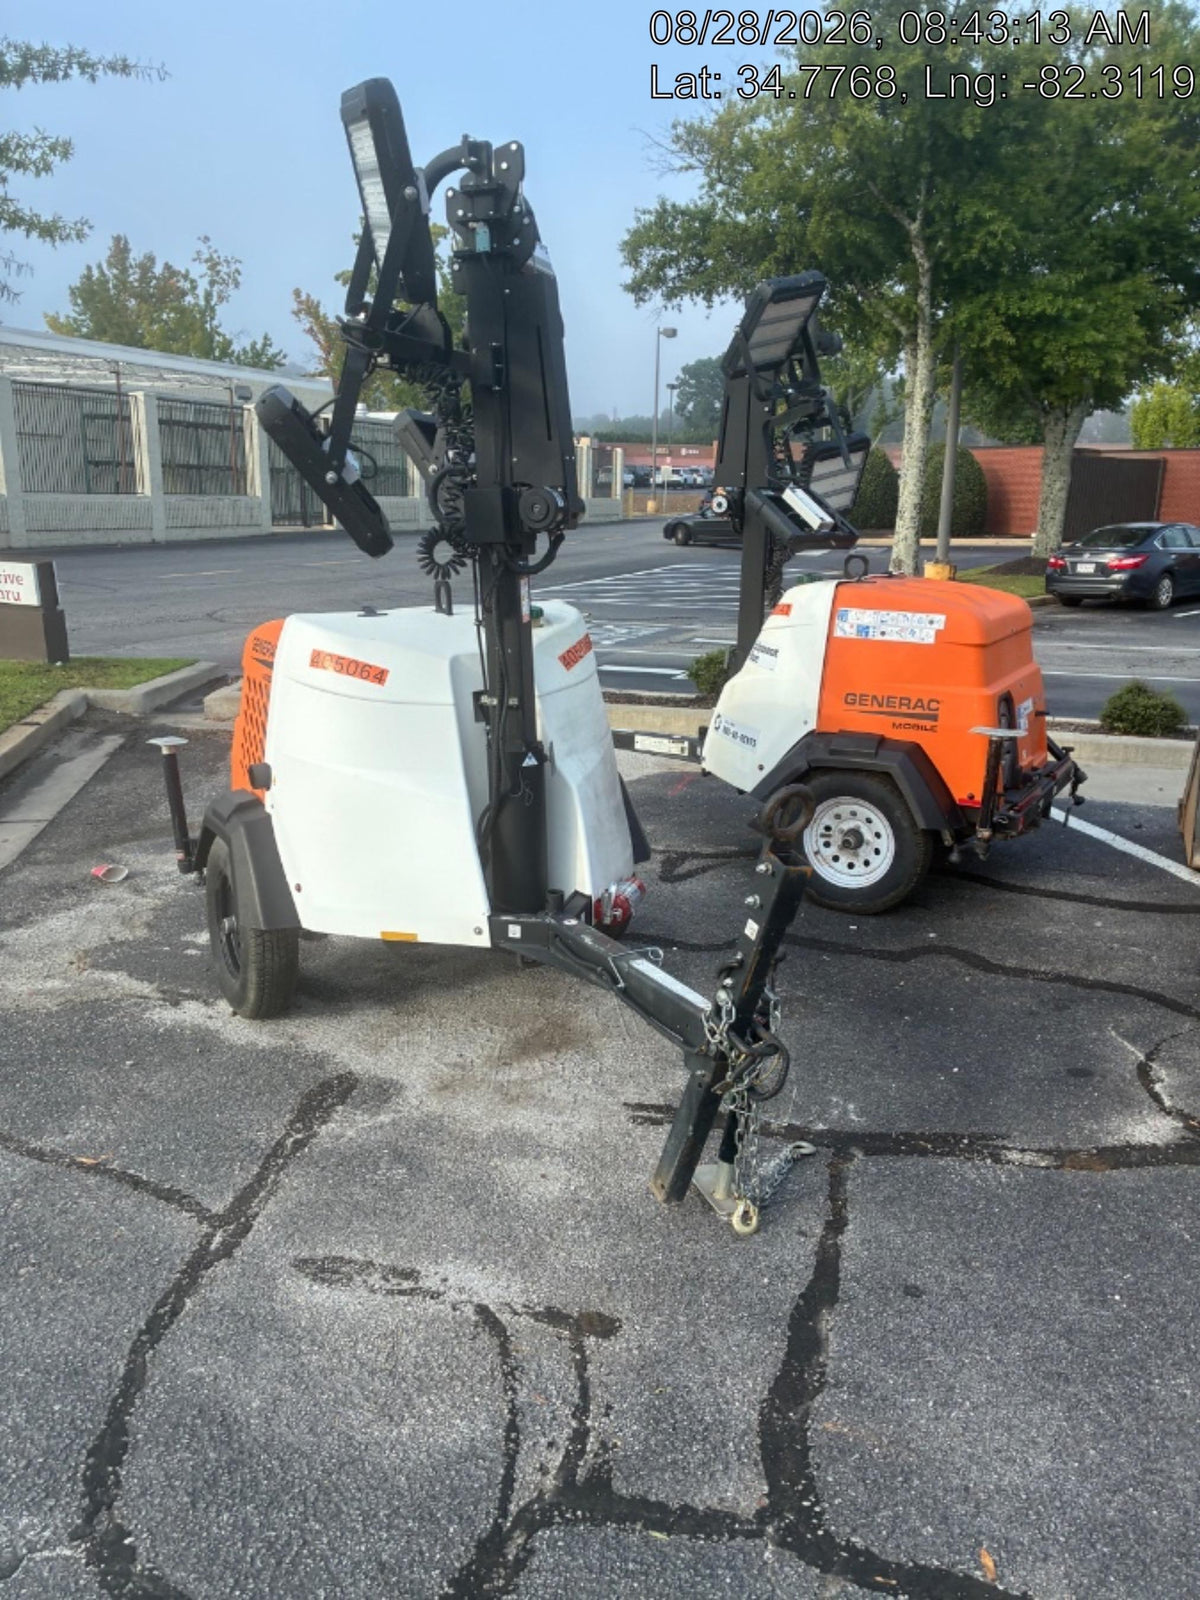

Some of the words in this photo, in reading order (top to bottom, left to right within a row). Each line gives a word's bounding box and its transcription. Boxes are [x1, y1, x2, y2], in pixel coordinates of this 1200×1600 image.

[311, 651, 386, 685] 405064
[844, 692, 941, 712] GENERAC
[891, 721, 938, 733] MOBILE
